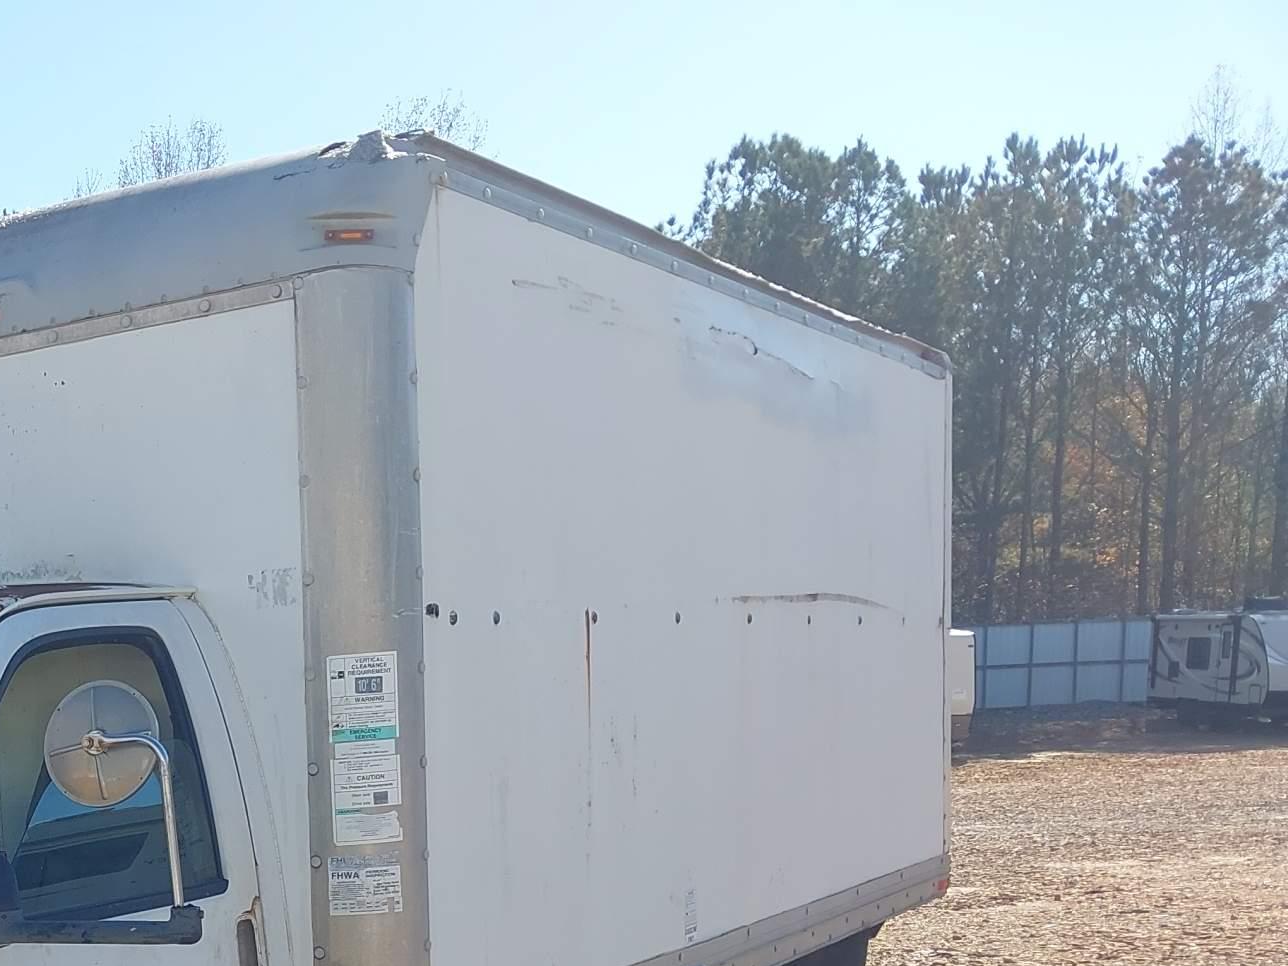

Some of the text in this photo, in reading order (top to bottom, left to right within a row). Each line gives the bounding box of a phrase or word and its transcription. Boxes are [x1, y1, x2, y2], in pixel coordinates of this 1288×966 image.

[354, 656, 385, 664] VERTICAL
[351, 662, 388, 670] CLEARANCE
[347, 668, 392, 676] REQUIREMENT
[354, 695, 385, 703] WARNING
[356, 774, 385, 782] CAUTION
[331, 871, 360, 880] FHWA
